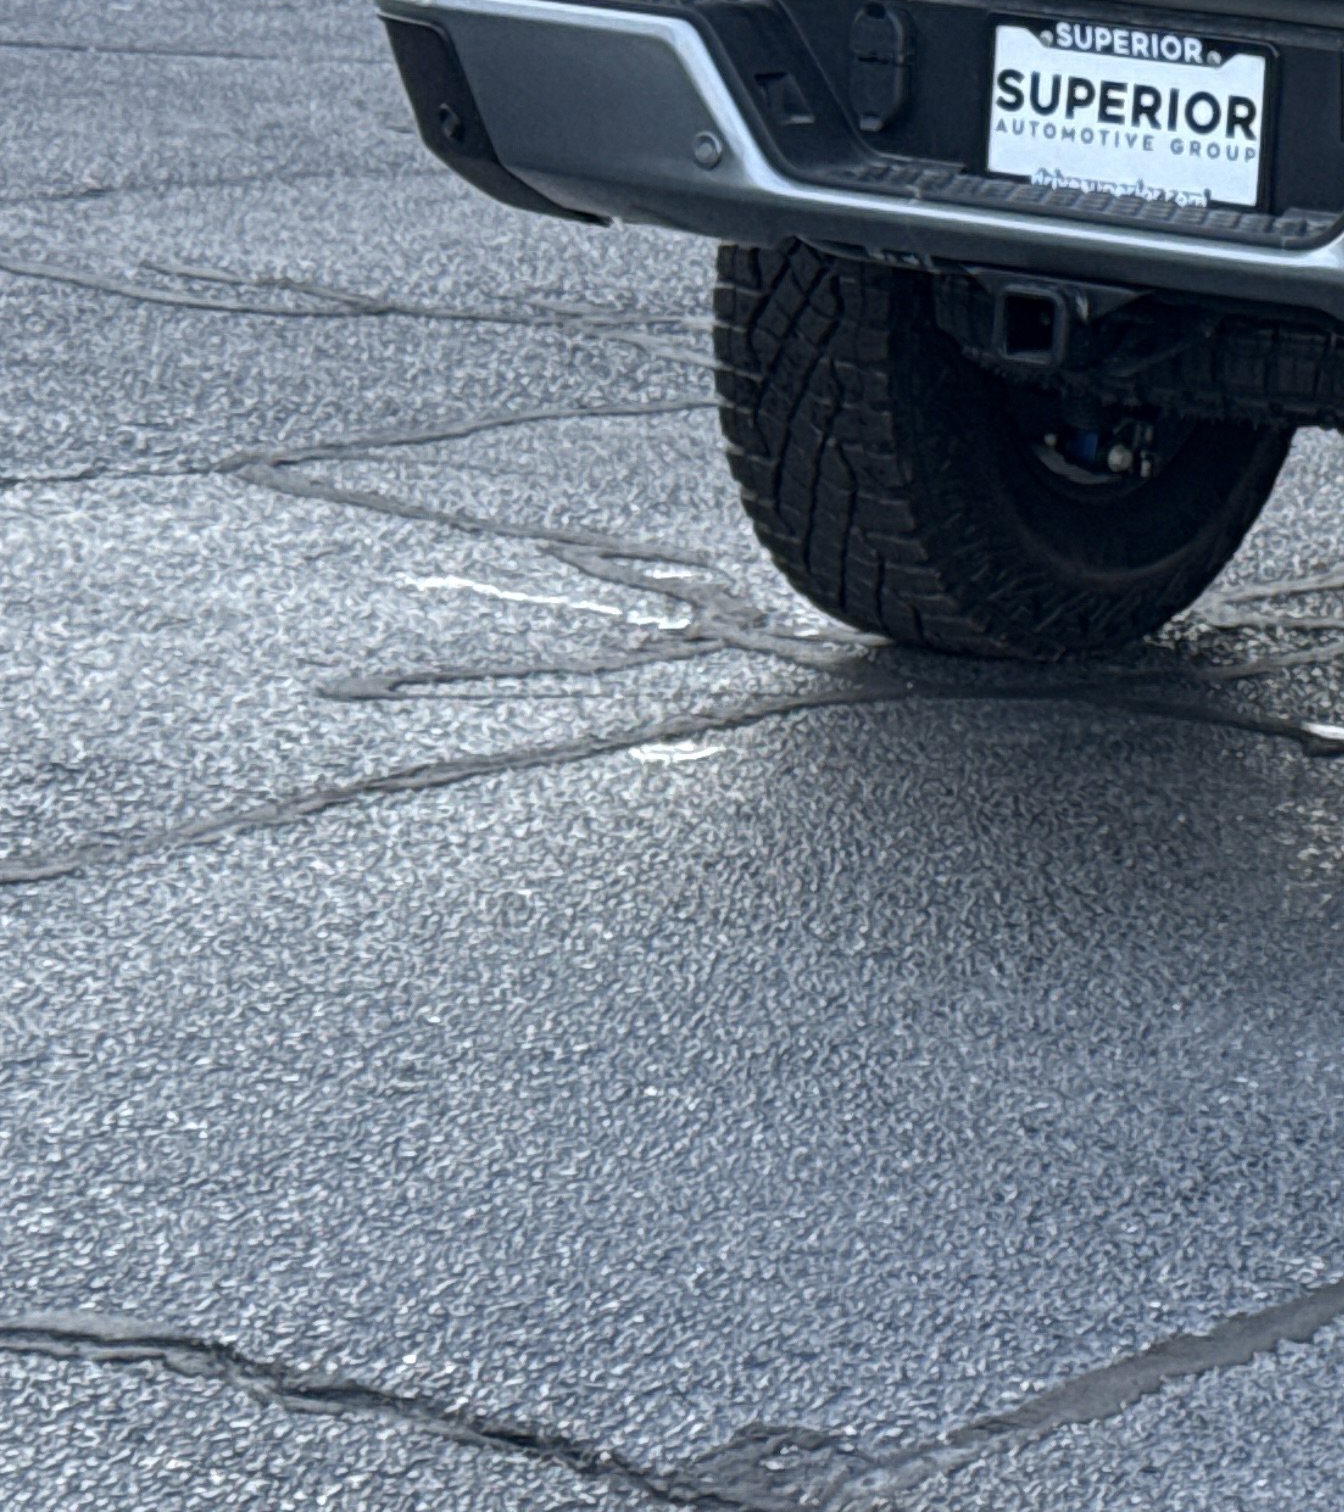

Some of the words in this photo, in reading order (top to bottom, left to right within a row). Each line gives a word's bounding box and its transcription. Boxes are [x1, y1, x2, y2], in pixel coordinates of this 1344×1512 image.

[1055, 21, 1203, 64] SUPERIOR
[996, 68, 1257, 141] SUPERIOR
[996, 118, 1155, 152] AUTOMOTIVE
[1170, 138, 1257, 163] GROUP
